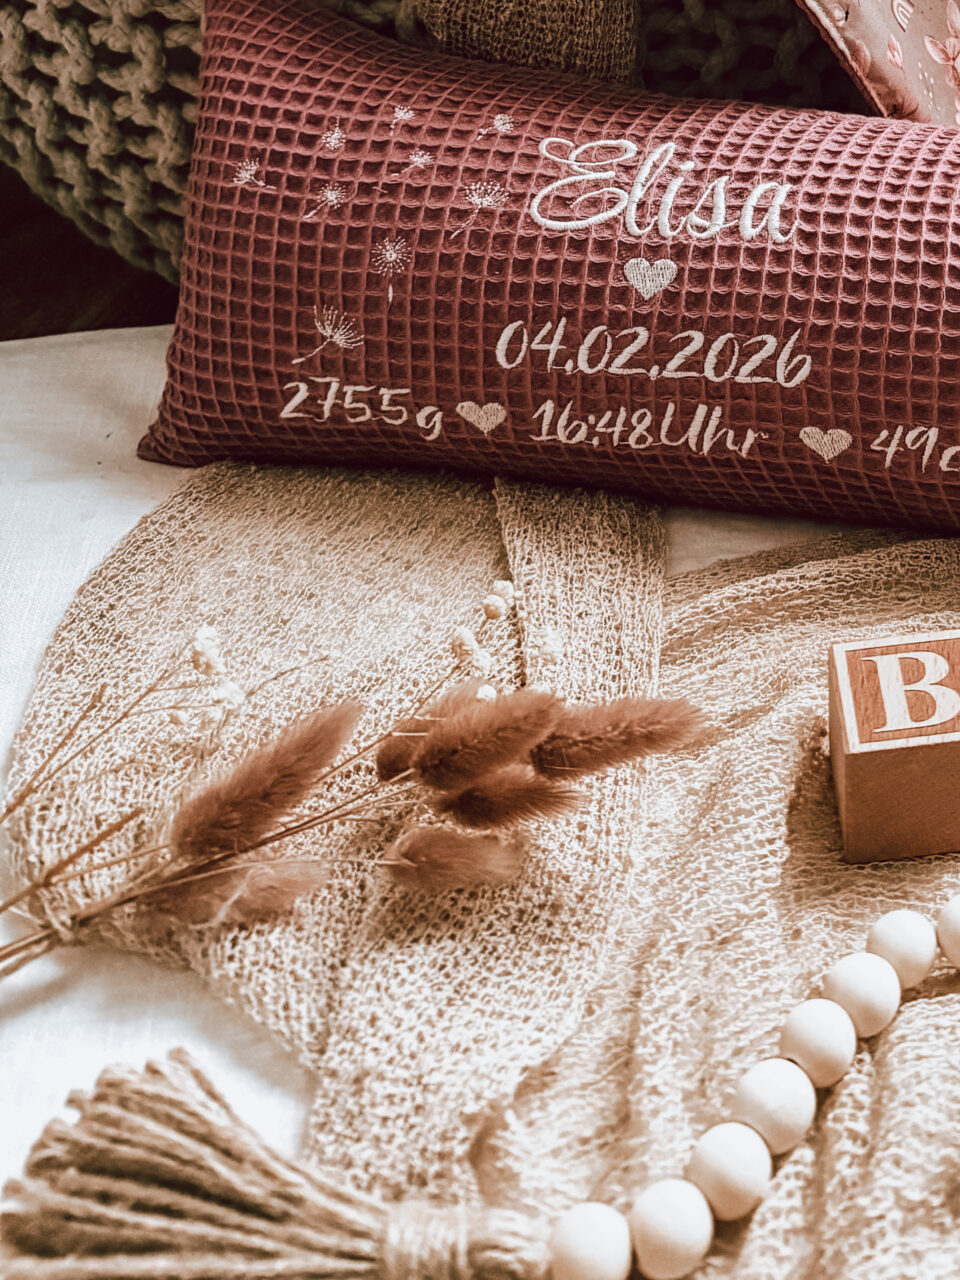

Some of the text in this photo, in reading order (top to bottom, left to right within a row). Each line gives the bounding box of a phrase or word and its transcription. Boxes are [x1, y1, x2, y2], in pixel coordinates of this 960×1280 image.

[531, 137, 799, 243] Elisa
[495, 317, 812, 388] 04.02.2026
[279, 376, 444, 441] 2755g
